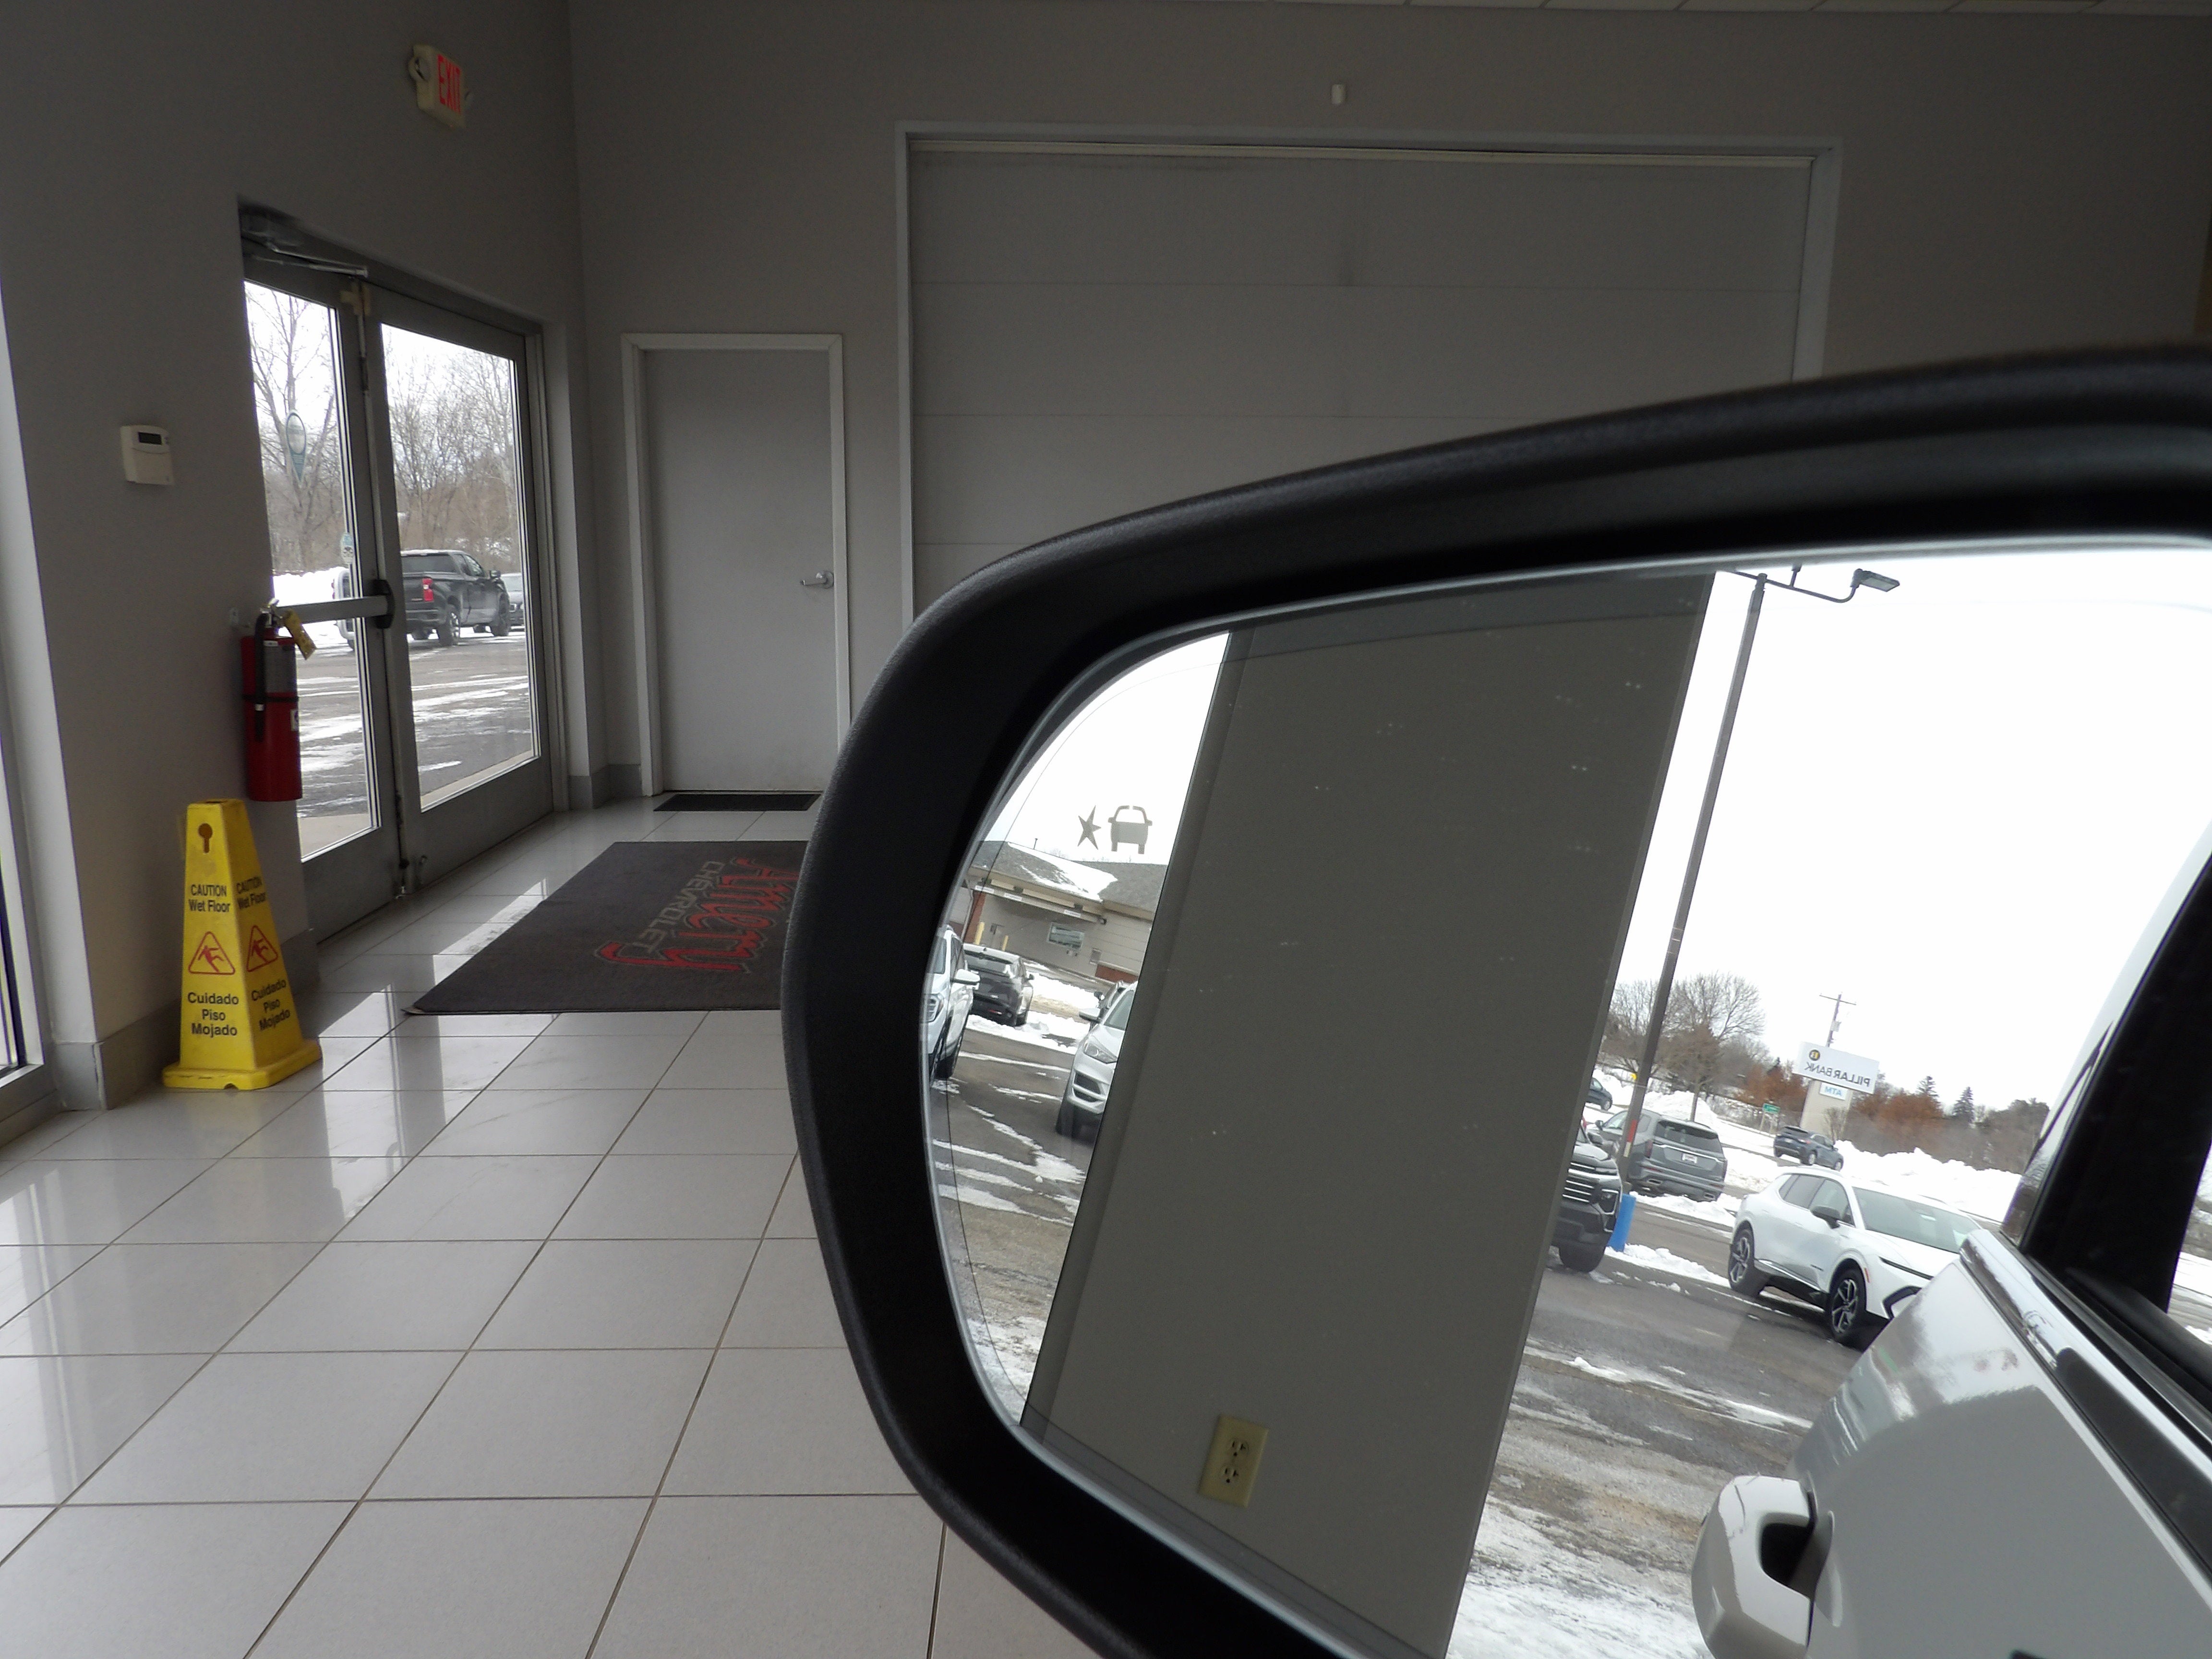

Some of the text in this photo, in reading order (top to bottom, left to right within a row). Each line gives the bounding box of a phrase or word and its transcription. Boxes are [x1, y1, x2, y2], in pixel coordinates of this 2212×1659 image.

[437, 54, 461, 115] EXIT
[191, 884, 227, 897] CAUTION
[236, 876, 263, 894] CAUTION
[189, 899, 230, 913] Wet Floor
[237, 892, 266, 910] Wet Floor
[633, 861, 724, 953] CHEVROLET
[599, 857, 800, 972] Amery
[188, 992, 239, 1005] Cuidado
[251, 979, 287, 1001] Cuidado
[202, 1009, 226, 1021] Piso
[263, 998, 281, 1014] Piso
[259, 1009, 290, 1031] Mojado
[192, 1022, 238, 1038] Mojado
